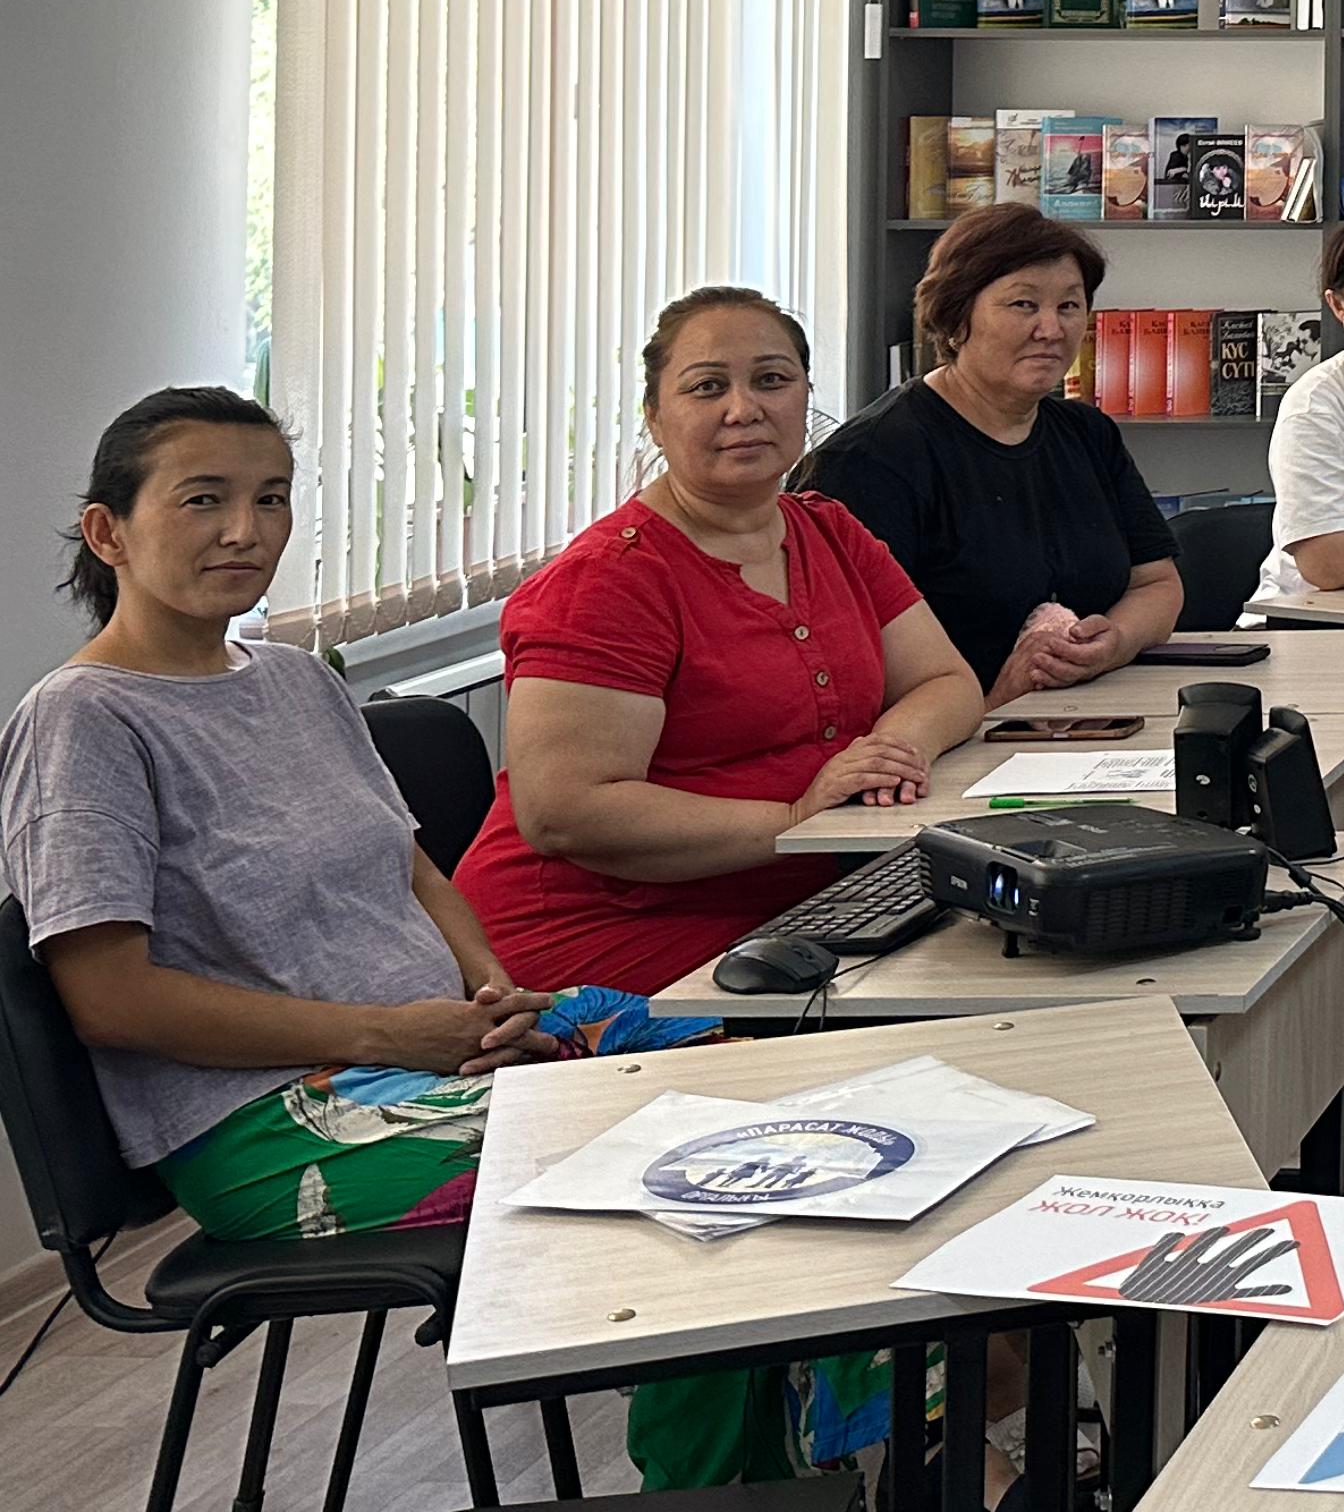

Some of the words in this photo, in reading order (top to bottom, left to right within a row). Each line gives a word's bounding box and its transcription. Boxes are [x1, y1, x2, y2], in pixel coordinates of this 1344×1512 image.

[1052, 1186, 1226, 1210] Жемқорлыққа
[1028, 1200, 1115, 1217] ЖОЛ
[1115, 1207, 1211, 1226] ЖОҚ!
